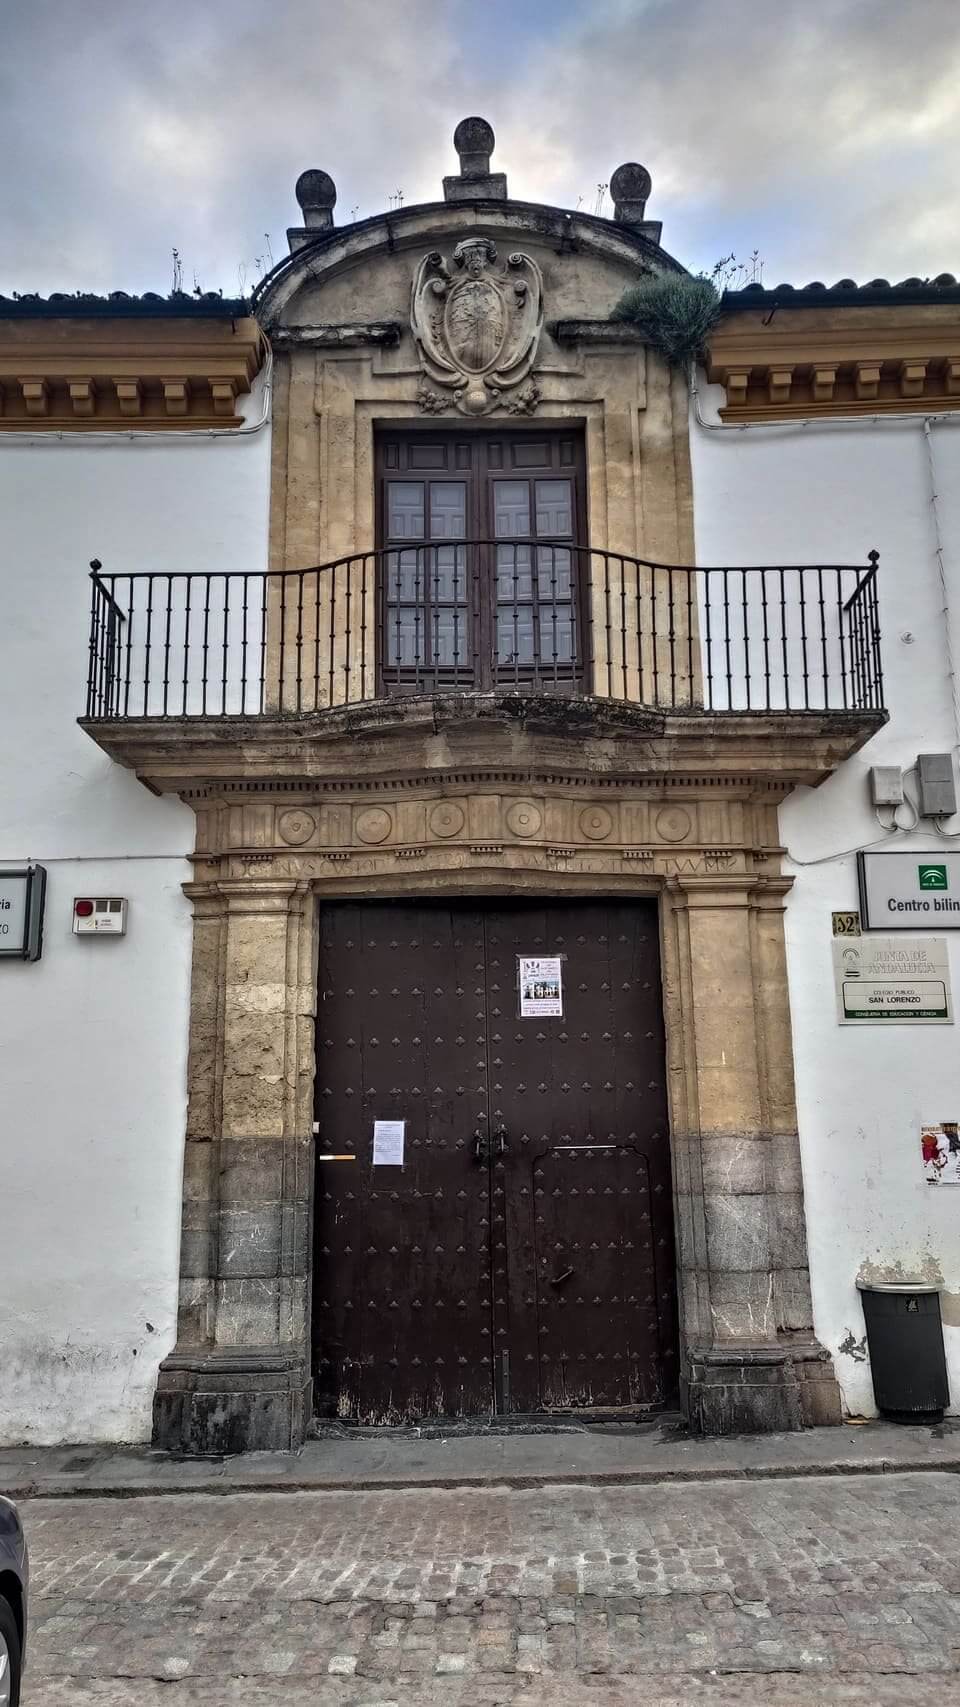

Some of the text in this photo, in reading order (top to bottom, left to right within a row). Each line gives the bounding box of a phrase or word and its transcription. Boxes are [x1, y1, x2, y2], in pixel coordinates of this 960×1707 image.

[888, 897, 960, 911] Centro bilin
[886, 996, 921, 1004] LORENZO
